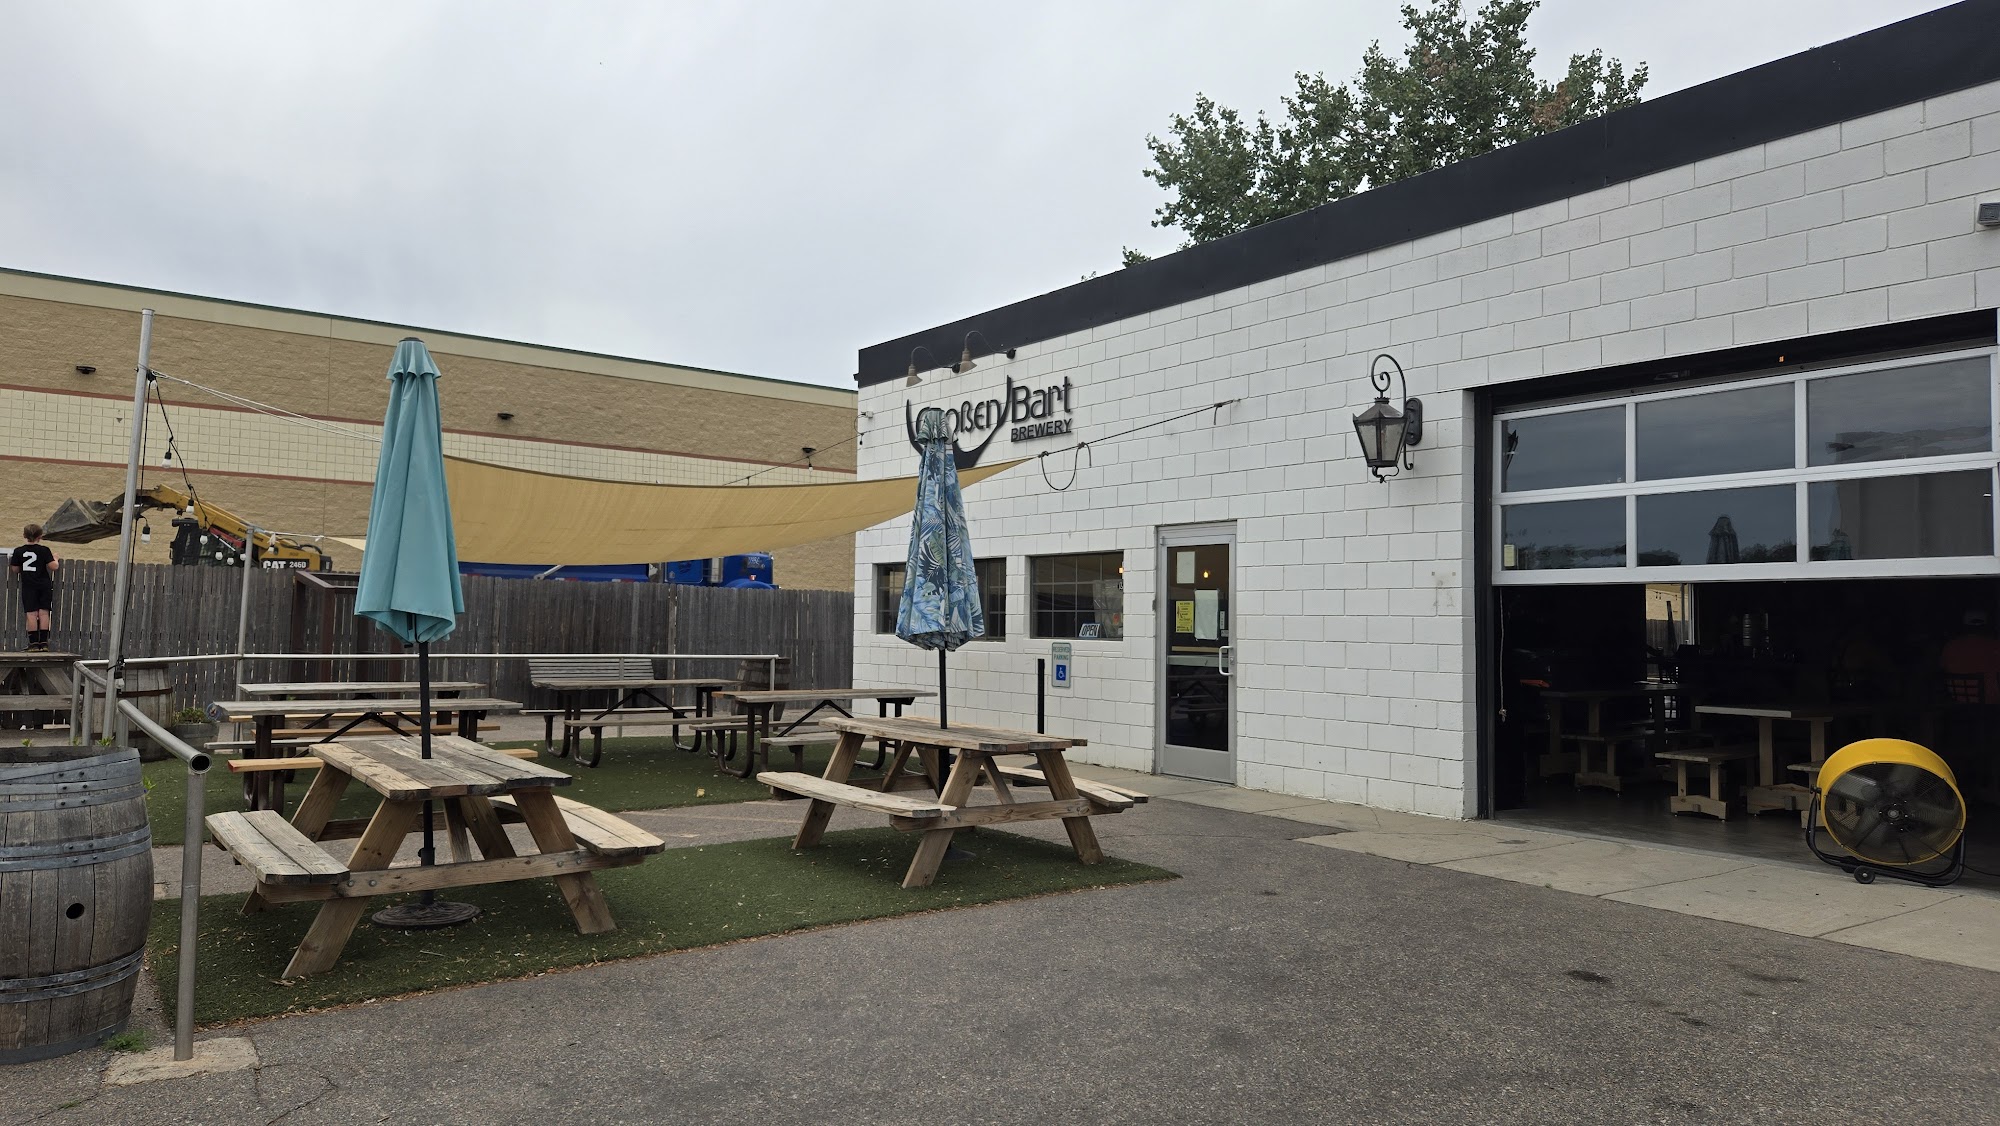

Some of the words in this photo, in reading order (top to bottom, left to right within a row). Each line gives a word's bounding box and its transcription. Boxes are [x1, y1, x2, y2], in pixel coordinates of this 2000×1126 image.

[1011, 376, 1072, 423] Bart
[1011, 418, 1072, 442] BREWERY
[22, 551, 37, 571] 2
[1081, 624, 1099, 636] OPEN
